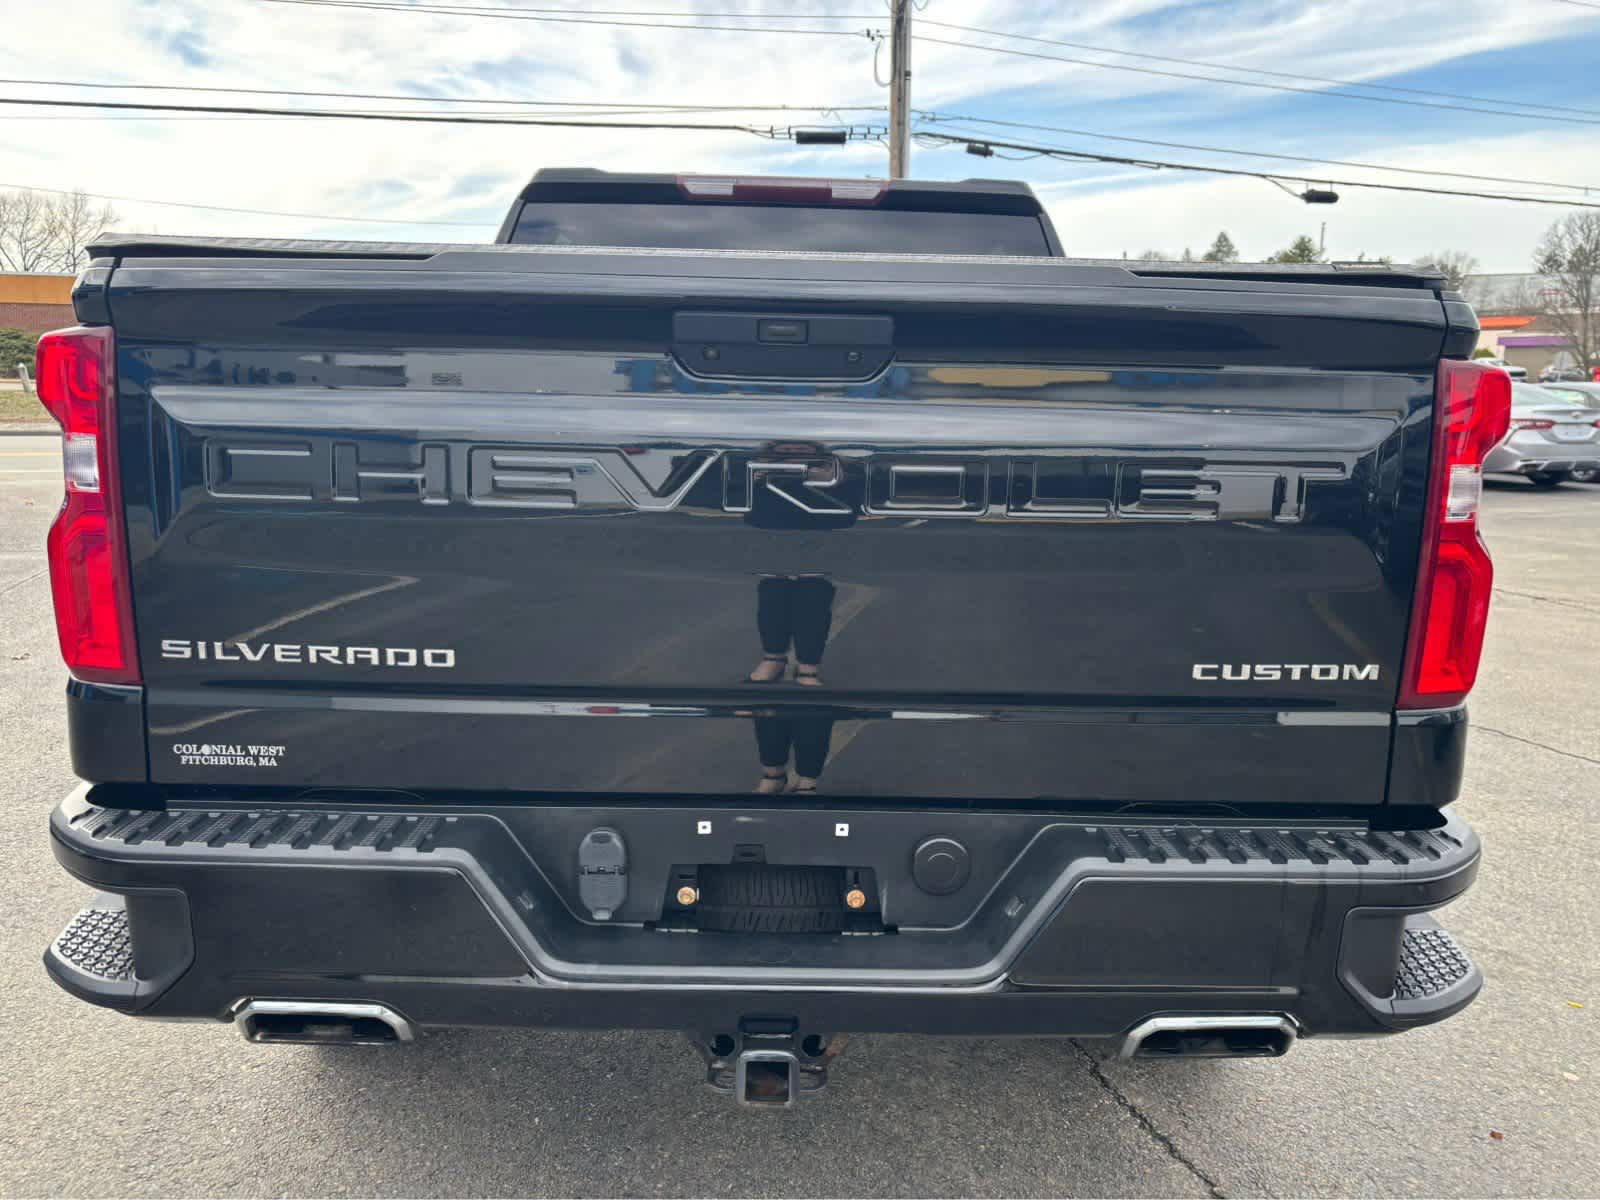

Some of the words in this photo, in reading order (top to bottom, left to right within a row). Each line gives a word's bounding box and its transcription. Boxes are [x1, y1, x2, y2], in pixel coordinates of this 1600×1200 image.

[203, 437, 1347, 522] CHEVROLET
[161, 639, 456, 668] SILVERADO
[1192, 664, 1380, 681] CUSTOM
[173, 743, 245, 756] COLONIAL
[248, 745, 286, 757] WEST
[180, 755, 257, 767] FITCHBURG,
[258, 757, 278, 767] MA
